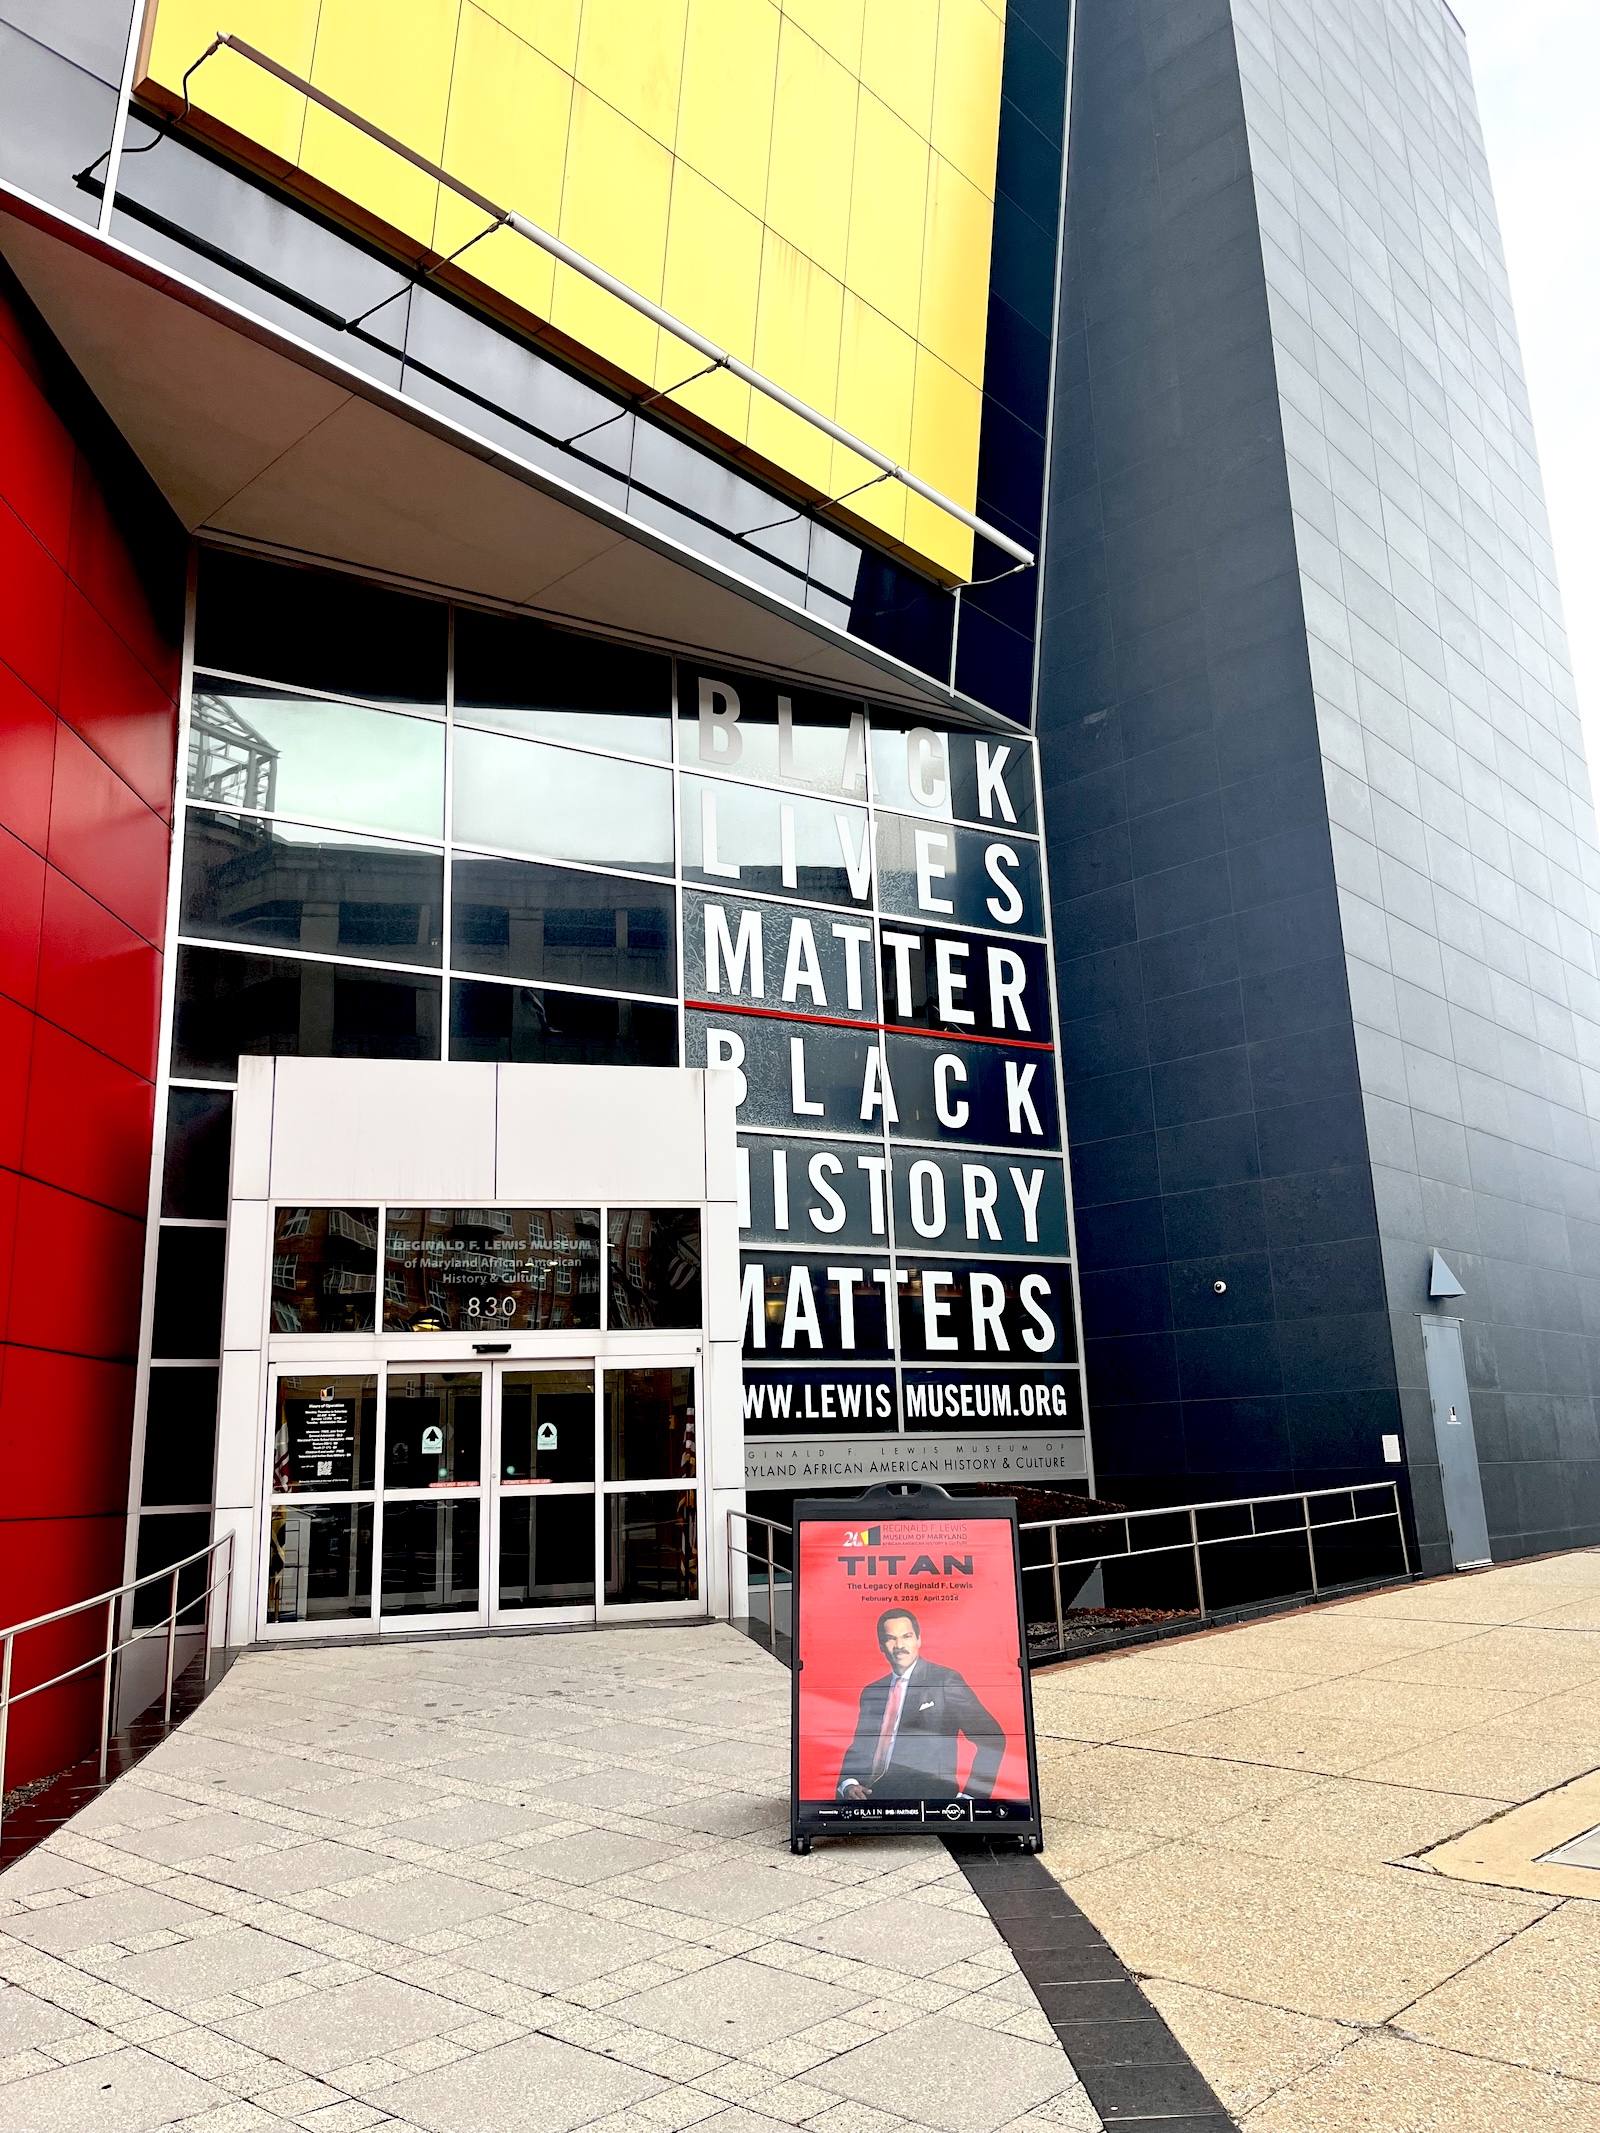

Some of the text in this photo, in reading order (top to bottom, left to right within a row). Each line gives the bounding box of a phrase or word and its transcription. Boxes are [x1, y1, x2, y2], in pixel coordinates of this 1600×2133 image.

[698, 677, 1018, 824] BLACK
[701, 789, 1023, 925] LIVES
[704, 903, 1031, 1032] MATTER
[706, 1027, 1043, 1136] BLACK
[393, 1240, 592, 1250] REGINALD F. LEWIS MUSEUM
[404, 1257, 581, 1270] of Maryland African Ameican
[443, 1273, 546, 1285] History & Culture
[467, 1296, 517, 1317] 830
[906, 1384, 1067, 1417] MUSEUM.ORG
[848, 1448, 856, 1456] F.
[881, 1446, 938, 1455] LEWIS
[956, 1444, 1029, 1453] MUSEUM
[1046, 1443, 1065, 1451] OF
[803, 1461, 863, 1475] AFRICAN
[870, 1459, 938, 1473] AMERICAN
[944, 1458, 997, 1471] HISTORY
[1002, 1457, 1011, 1469] &
[1016, 1456, 1066, 1469] CULTURE
[882, 1524, 928, 1532] REGINALD
[939, 1523, 967, 1532] LEWIS
[838, 1555, 973, 1576] TITAN
[863, 1583, 893, 1591] Legacy
[903, 1582, 940, 1591] Reginald
[853, 1809, 882, 1817] GRAIN
